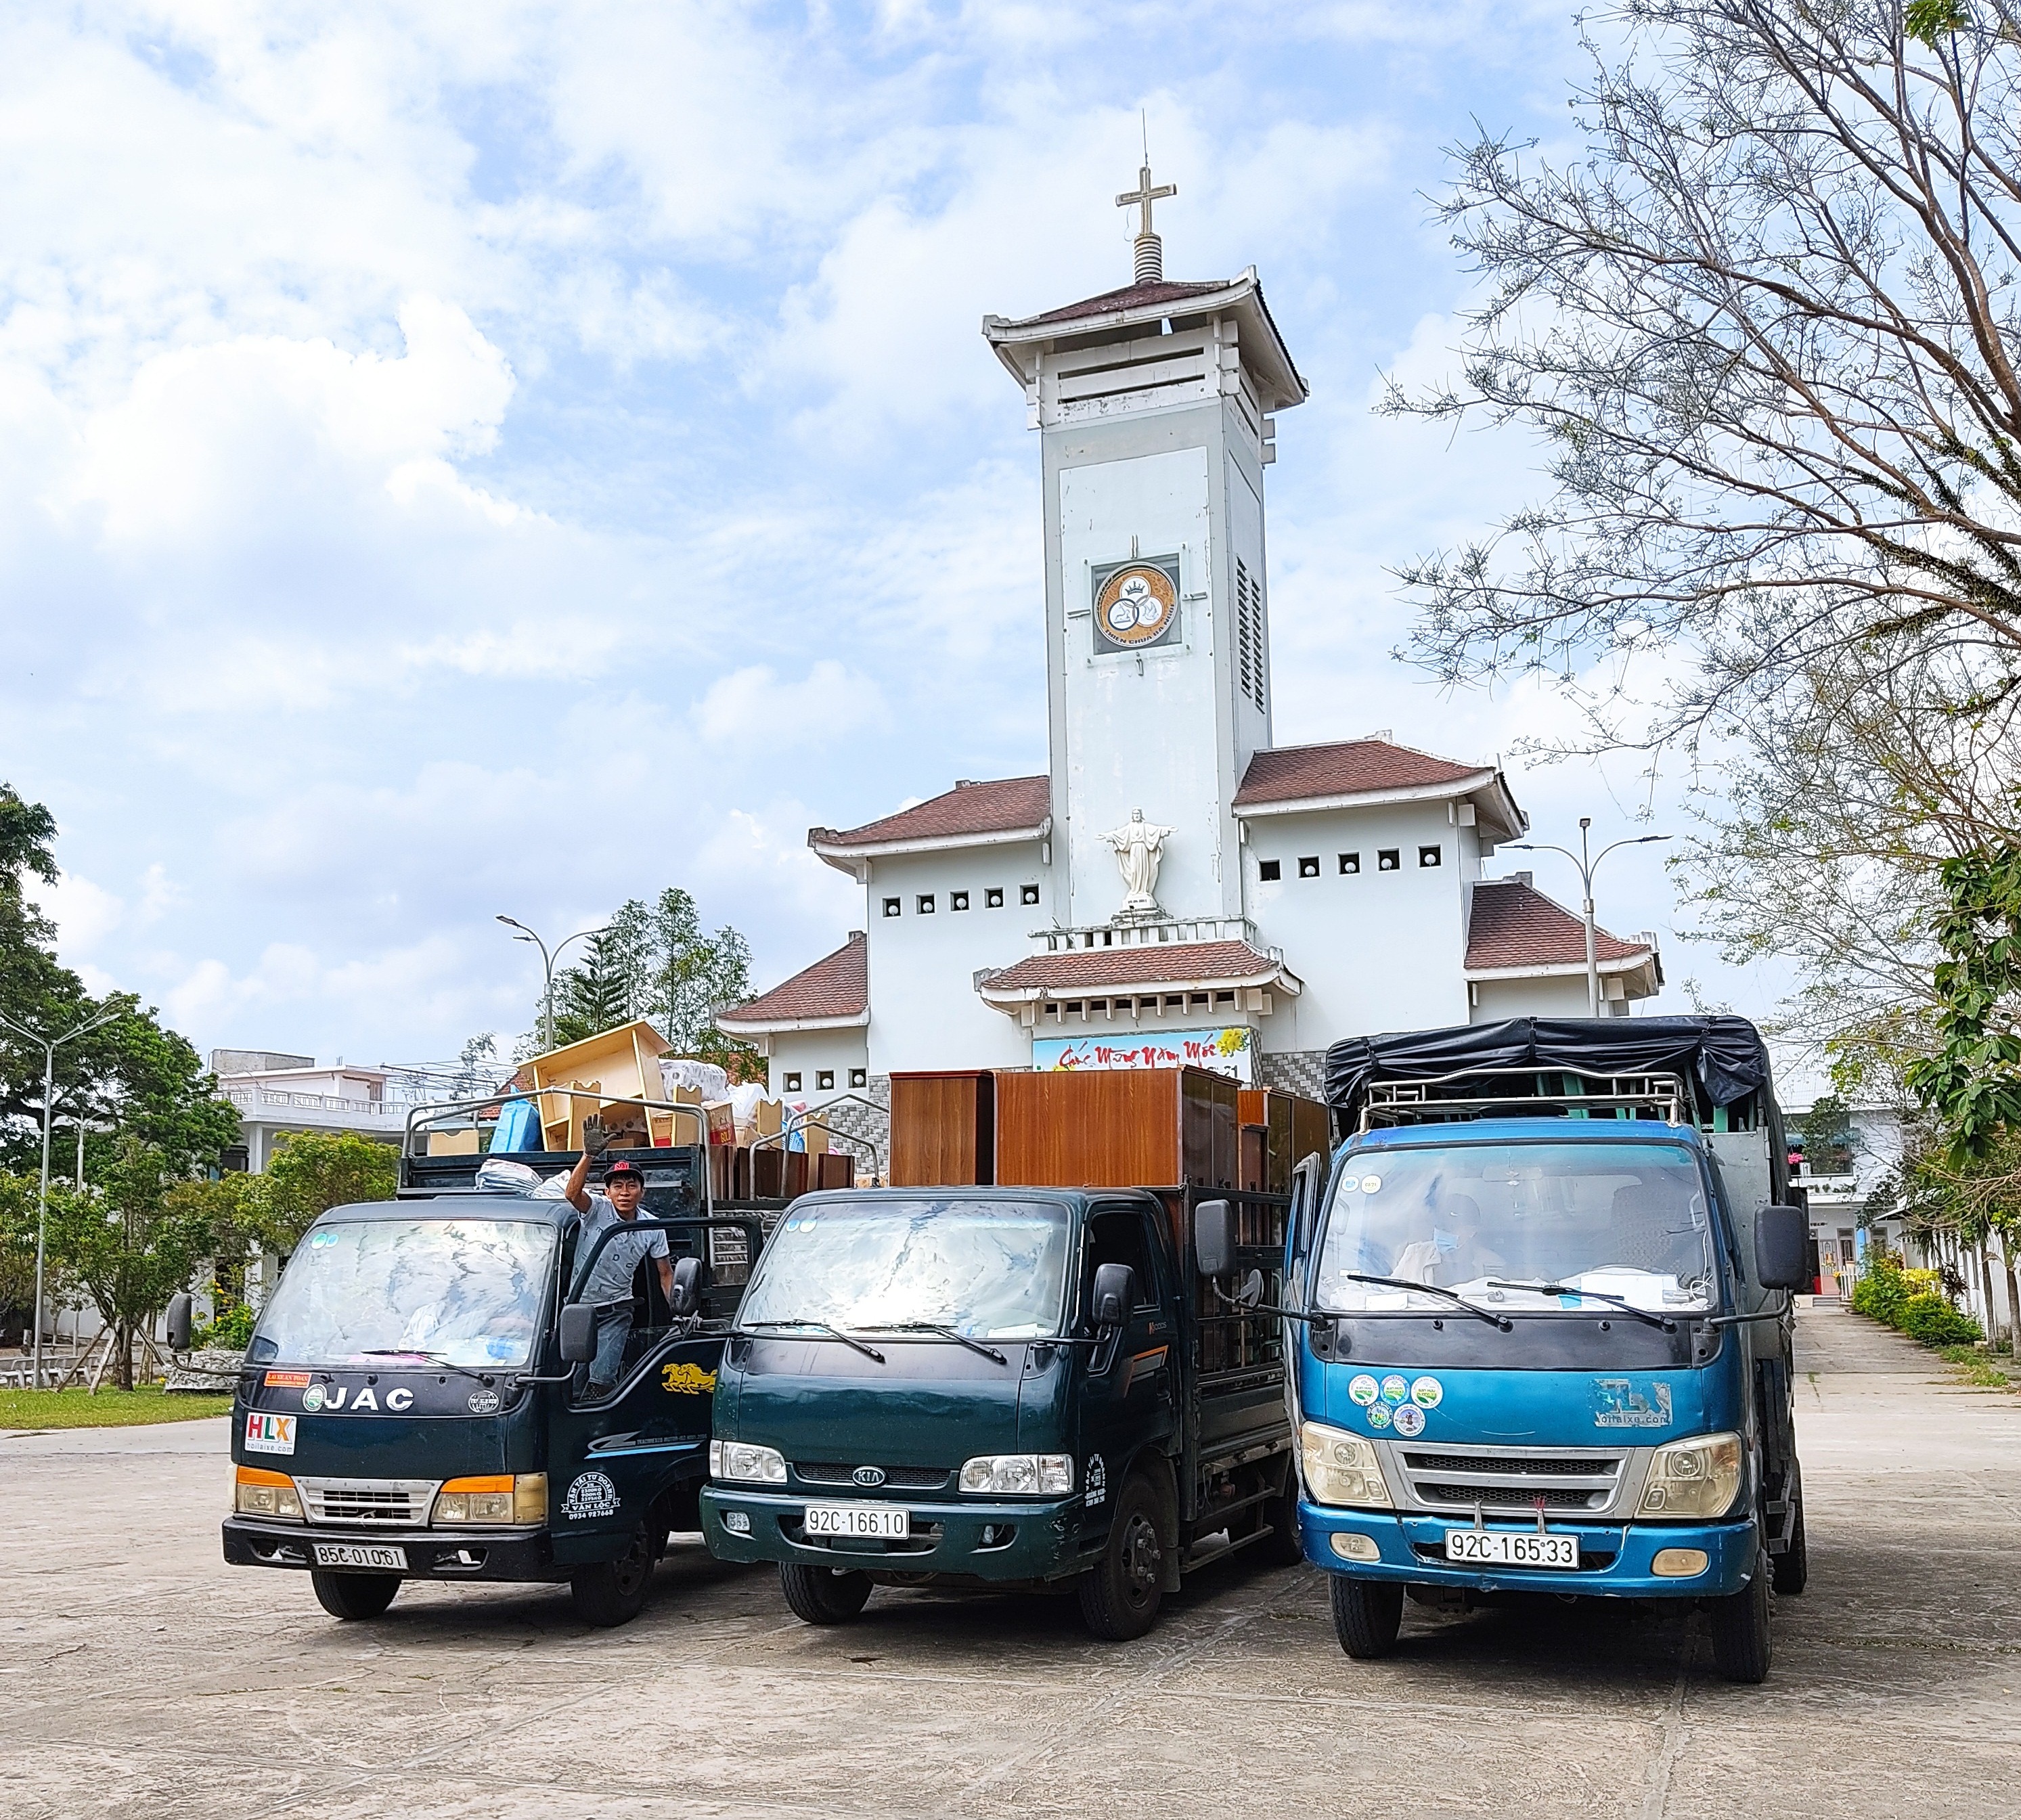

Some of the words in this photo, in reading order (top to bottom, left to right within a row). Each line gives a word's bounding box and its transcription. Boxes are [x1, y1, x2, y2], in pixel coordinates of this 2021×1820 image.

[324, 1387, 414, 1411] JAC
[248, 1415, 292, 1442] HLX
[246, 1442, 293, 1453] hoilaixe.com
[858, 1471, 880, 1482] KIA
[569, 1512, 587, 1520] 0934
[809, 1510, 904, 1534] 92C-166.10
[318, 1547, 401, 1567] 85C-010.61
[1452, 1534, 1572, 1563] 92C-165.33
